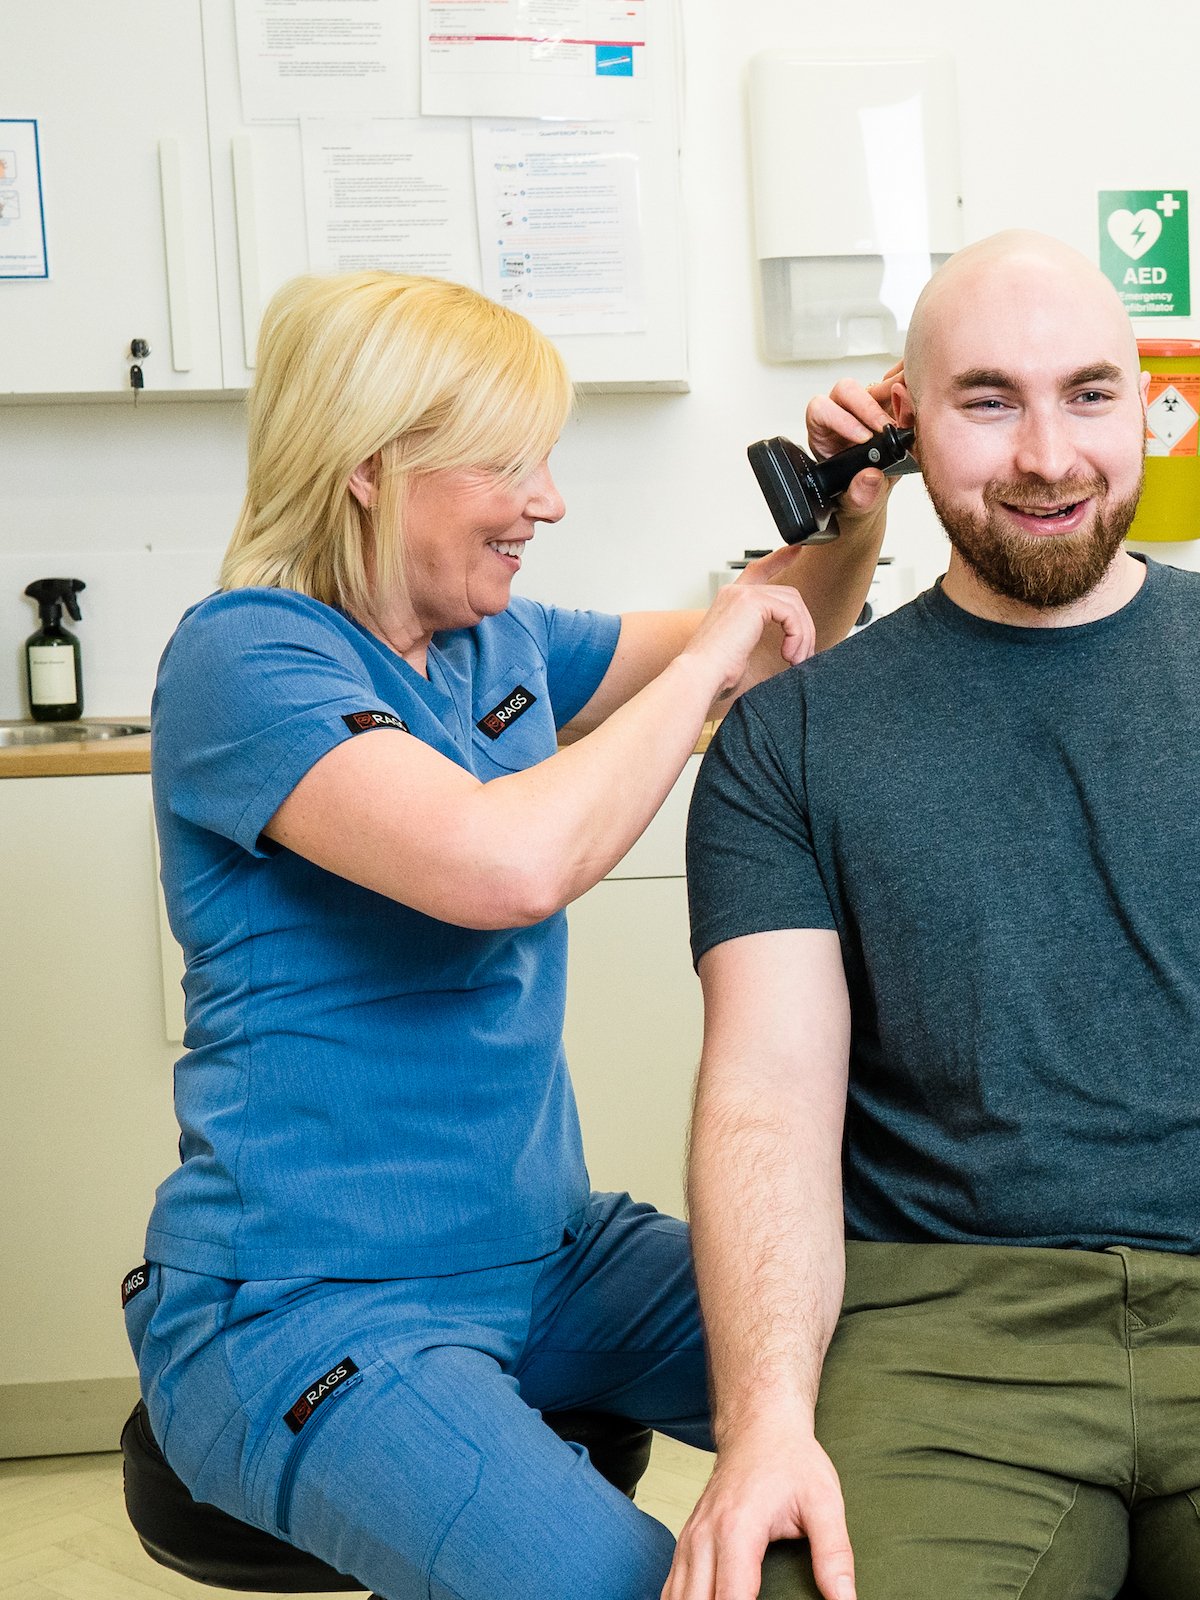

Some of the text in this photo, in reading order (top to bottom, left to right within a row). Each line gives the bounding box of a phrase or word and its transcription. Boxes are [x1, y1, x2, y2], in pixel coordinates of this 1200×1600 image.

[1123, 267, 1167, 285] AED
[1119, 291, 1173, 302] Emergency
[1125, 303, 1174, 312] efibrillator
[496, 693, 527, 722] RAGS
[306, 1365, 347, 1405] RAGS
